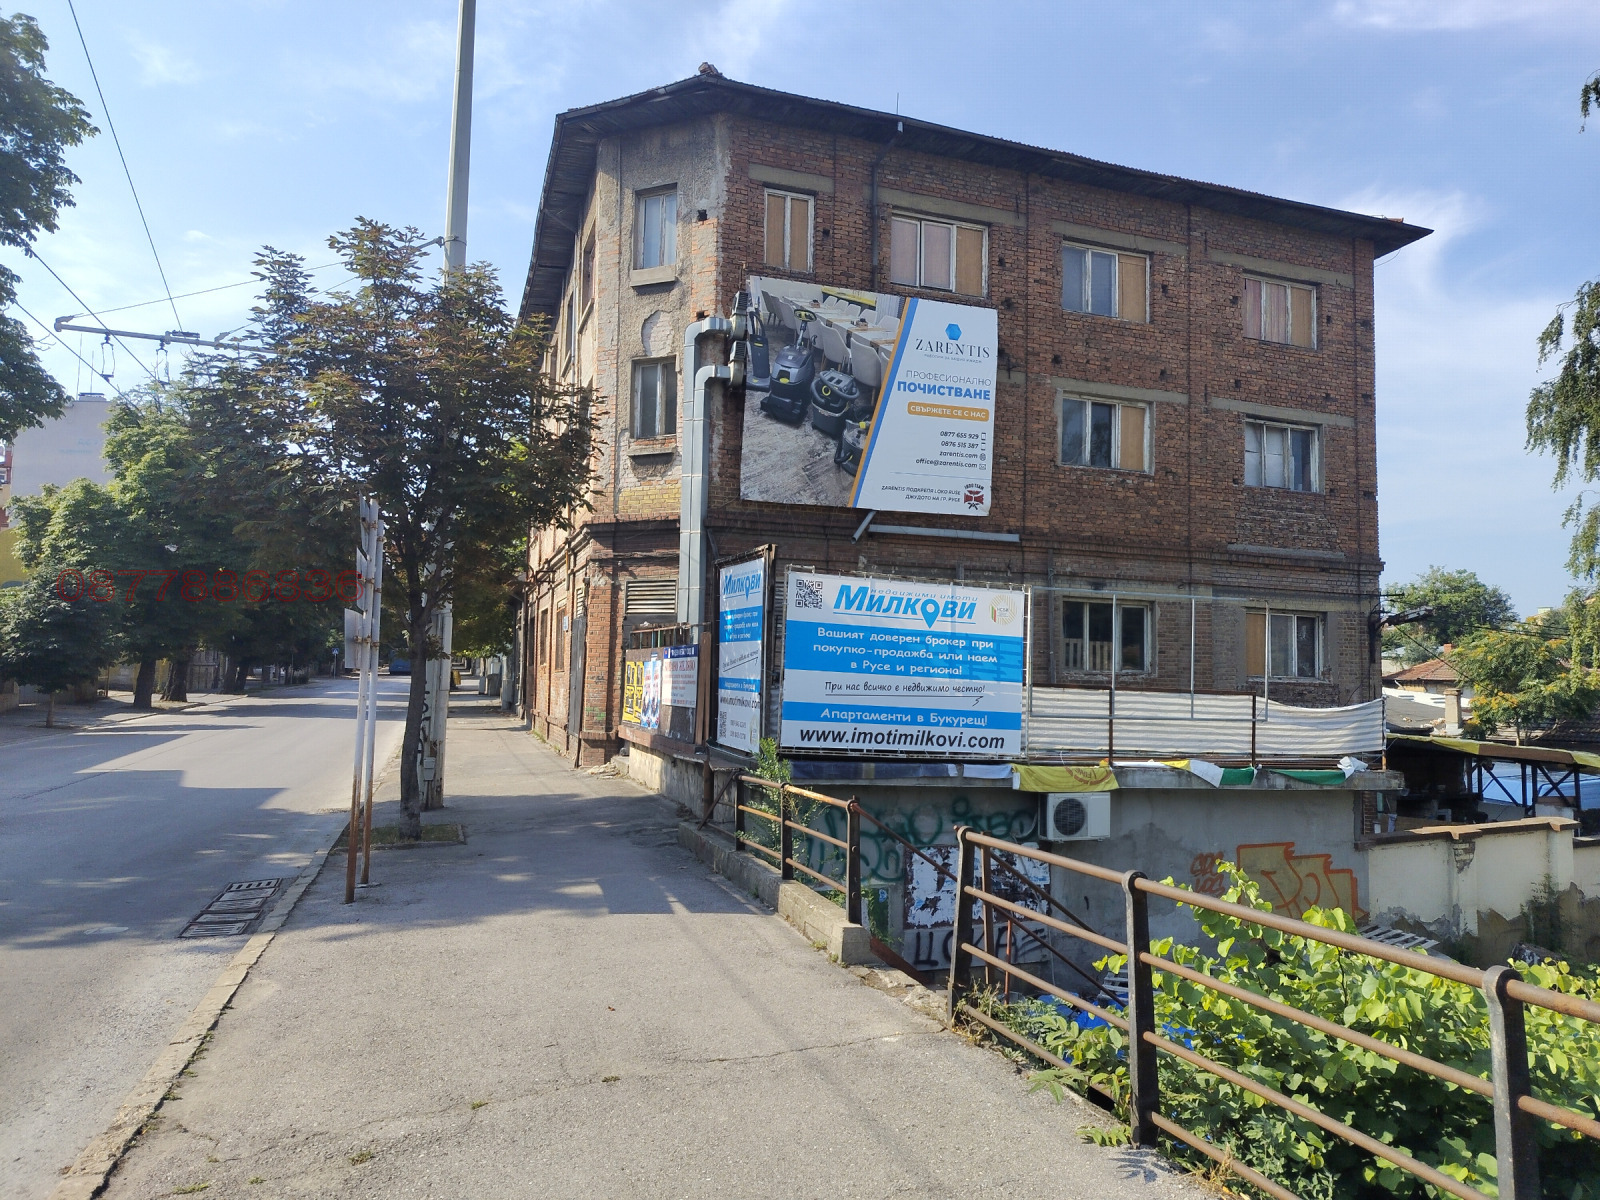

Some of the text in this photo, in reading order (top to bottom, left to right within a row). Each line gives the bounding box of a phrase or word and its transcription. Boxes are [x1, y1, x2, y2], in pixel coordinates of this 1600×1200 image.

[915, 338, 990, 359] ZARENTIS
[906, 370, 992, 386] ПРОФЕСИОНАЛНО
[897, 380, 991, 400] ПОЧИСТВАНЕ
[910, 405, 951, 415] СВЪРЖЕТЕ
[952, 408, 964, 416] СЕ
[970, 410, 986, 418] НАС
[916, 458, 978, 468] office@zarentis.com
[940, 450, 978, 459] zarentis.com
[818, 628, 994, 649] Вашият доверен брокер при
[813, 644, 998, 663] покупко-продажба или наем
[850, 660, 962, 675] в Русе и региона!
[824, 681, 843, 693] При
[845, 683, 861, 691] нас
[863, 681, 892, 692] всичко
[902, 682, 950, 693] недвижимо
[952, 684, 986, 693] честно!
[820, 708, 911, 722] Апартаменти
[930, 713, 988, 726] Букурещ!
[800, 728, 1005, 749] www.imotimilkovi.com
